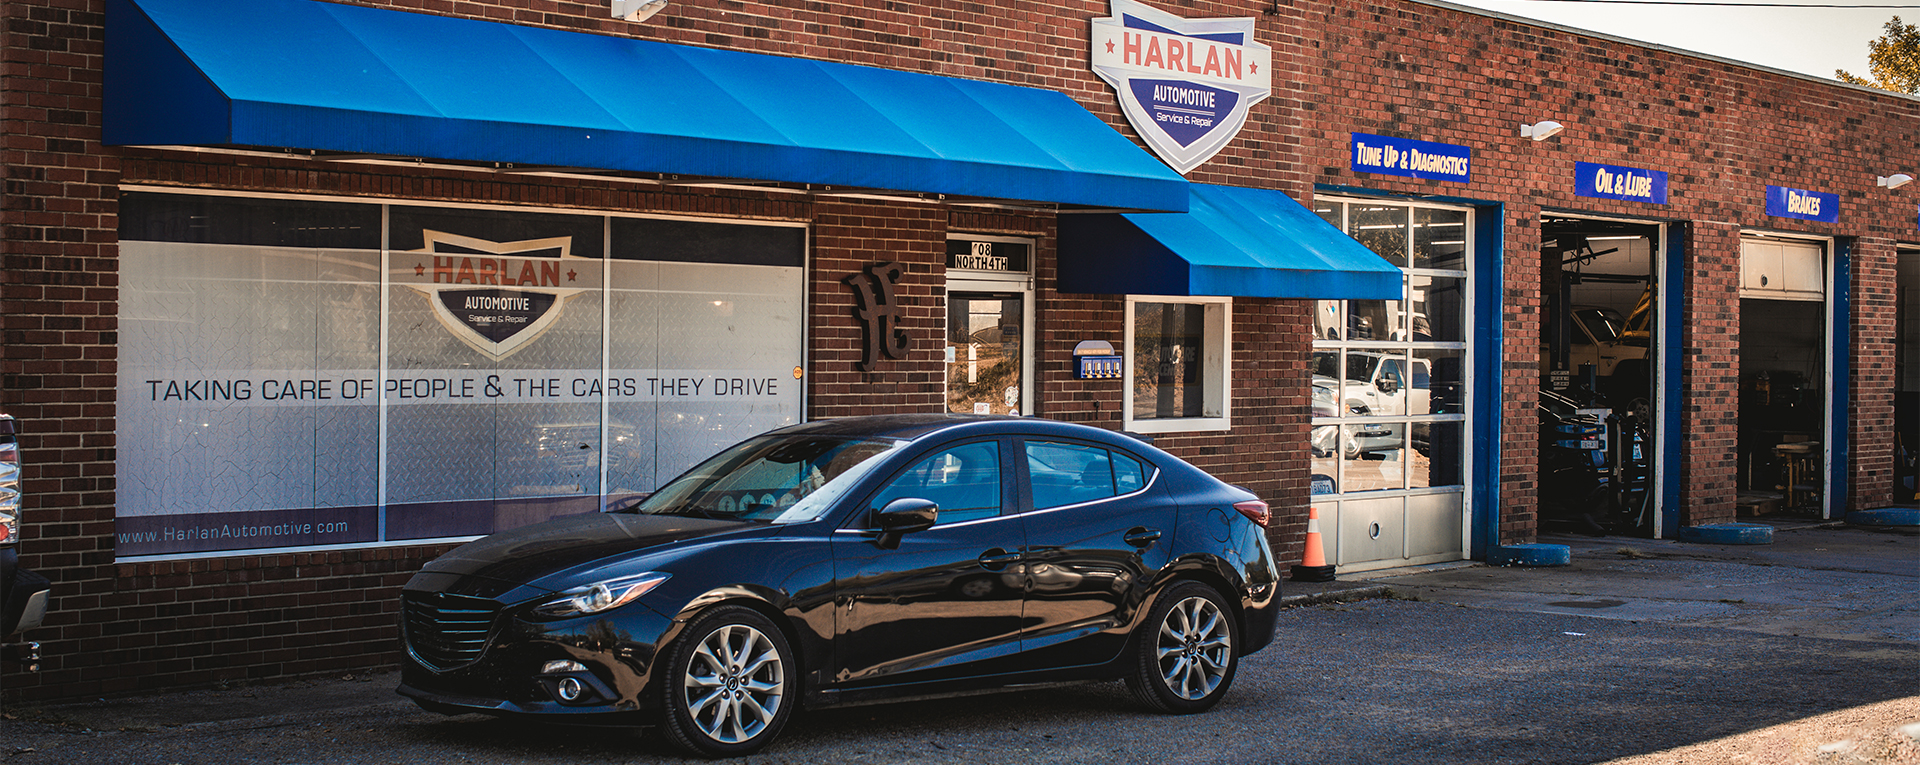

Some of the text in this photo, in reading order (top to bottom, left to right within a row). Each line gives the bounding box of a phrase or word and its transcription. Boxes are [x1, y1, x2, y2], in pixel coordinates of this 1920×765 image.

[1123, 31, 1242, 80] HARLAN
[1153, 84, 1216, 108] AUTOMOTIVE
[1156, 112, 1213, 128] Service & Repair
[1400, 151, 1408, 170] &
[1614, 173, 1624, 194] &
[973, 243, 991, 256] 08
[433, 256, 560, 287] HARLAN
[464, 296, 529, 311] AUTOMOTIVE
[468, 314, 528, 325] Service & Repair
[146, 374, 778, 401] TAKING CARE OF PEOPLE & THE CARS THEY DRIVE
[118, 521, 348, 544] www.HarlanAutomotive.com
